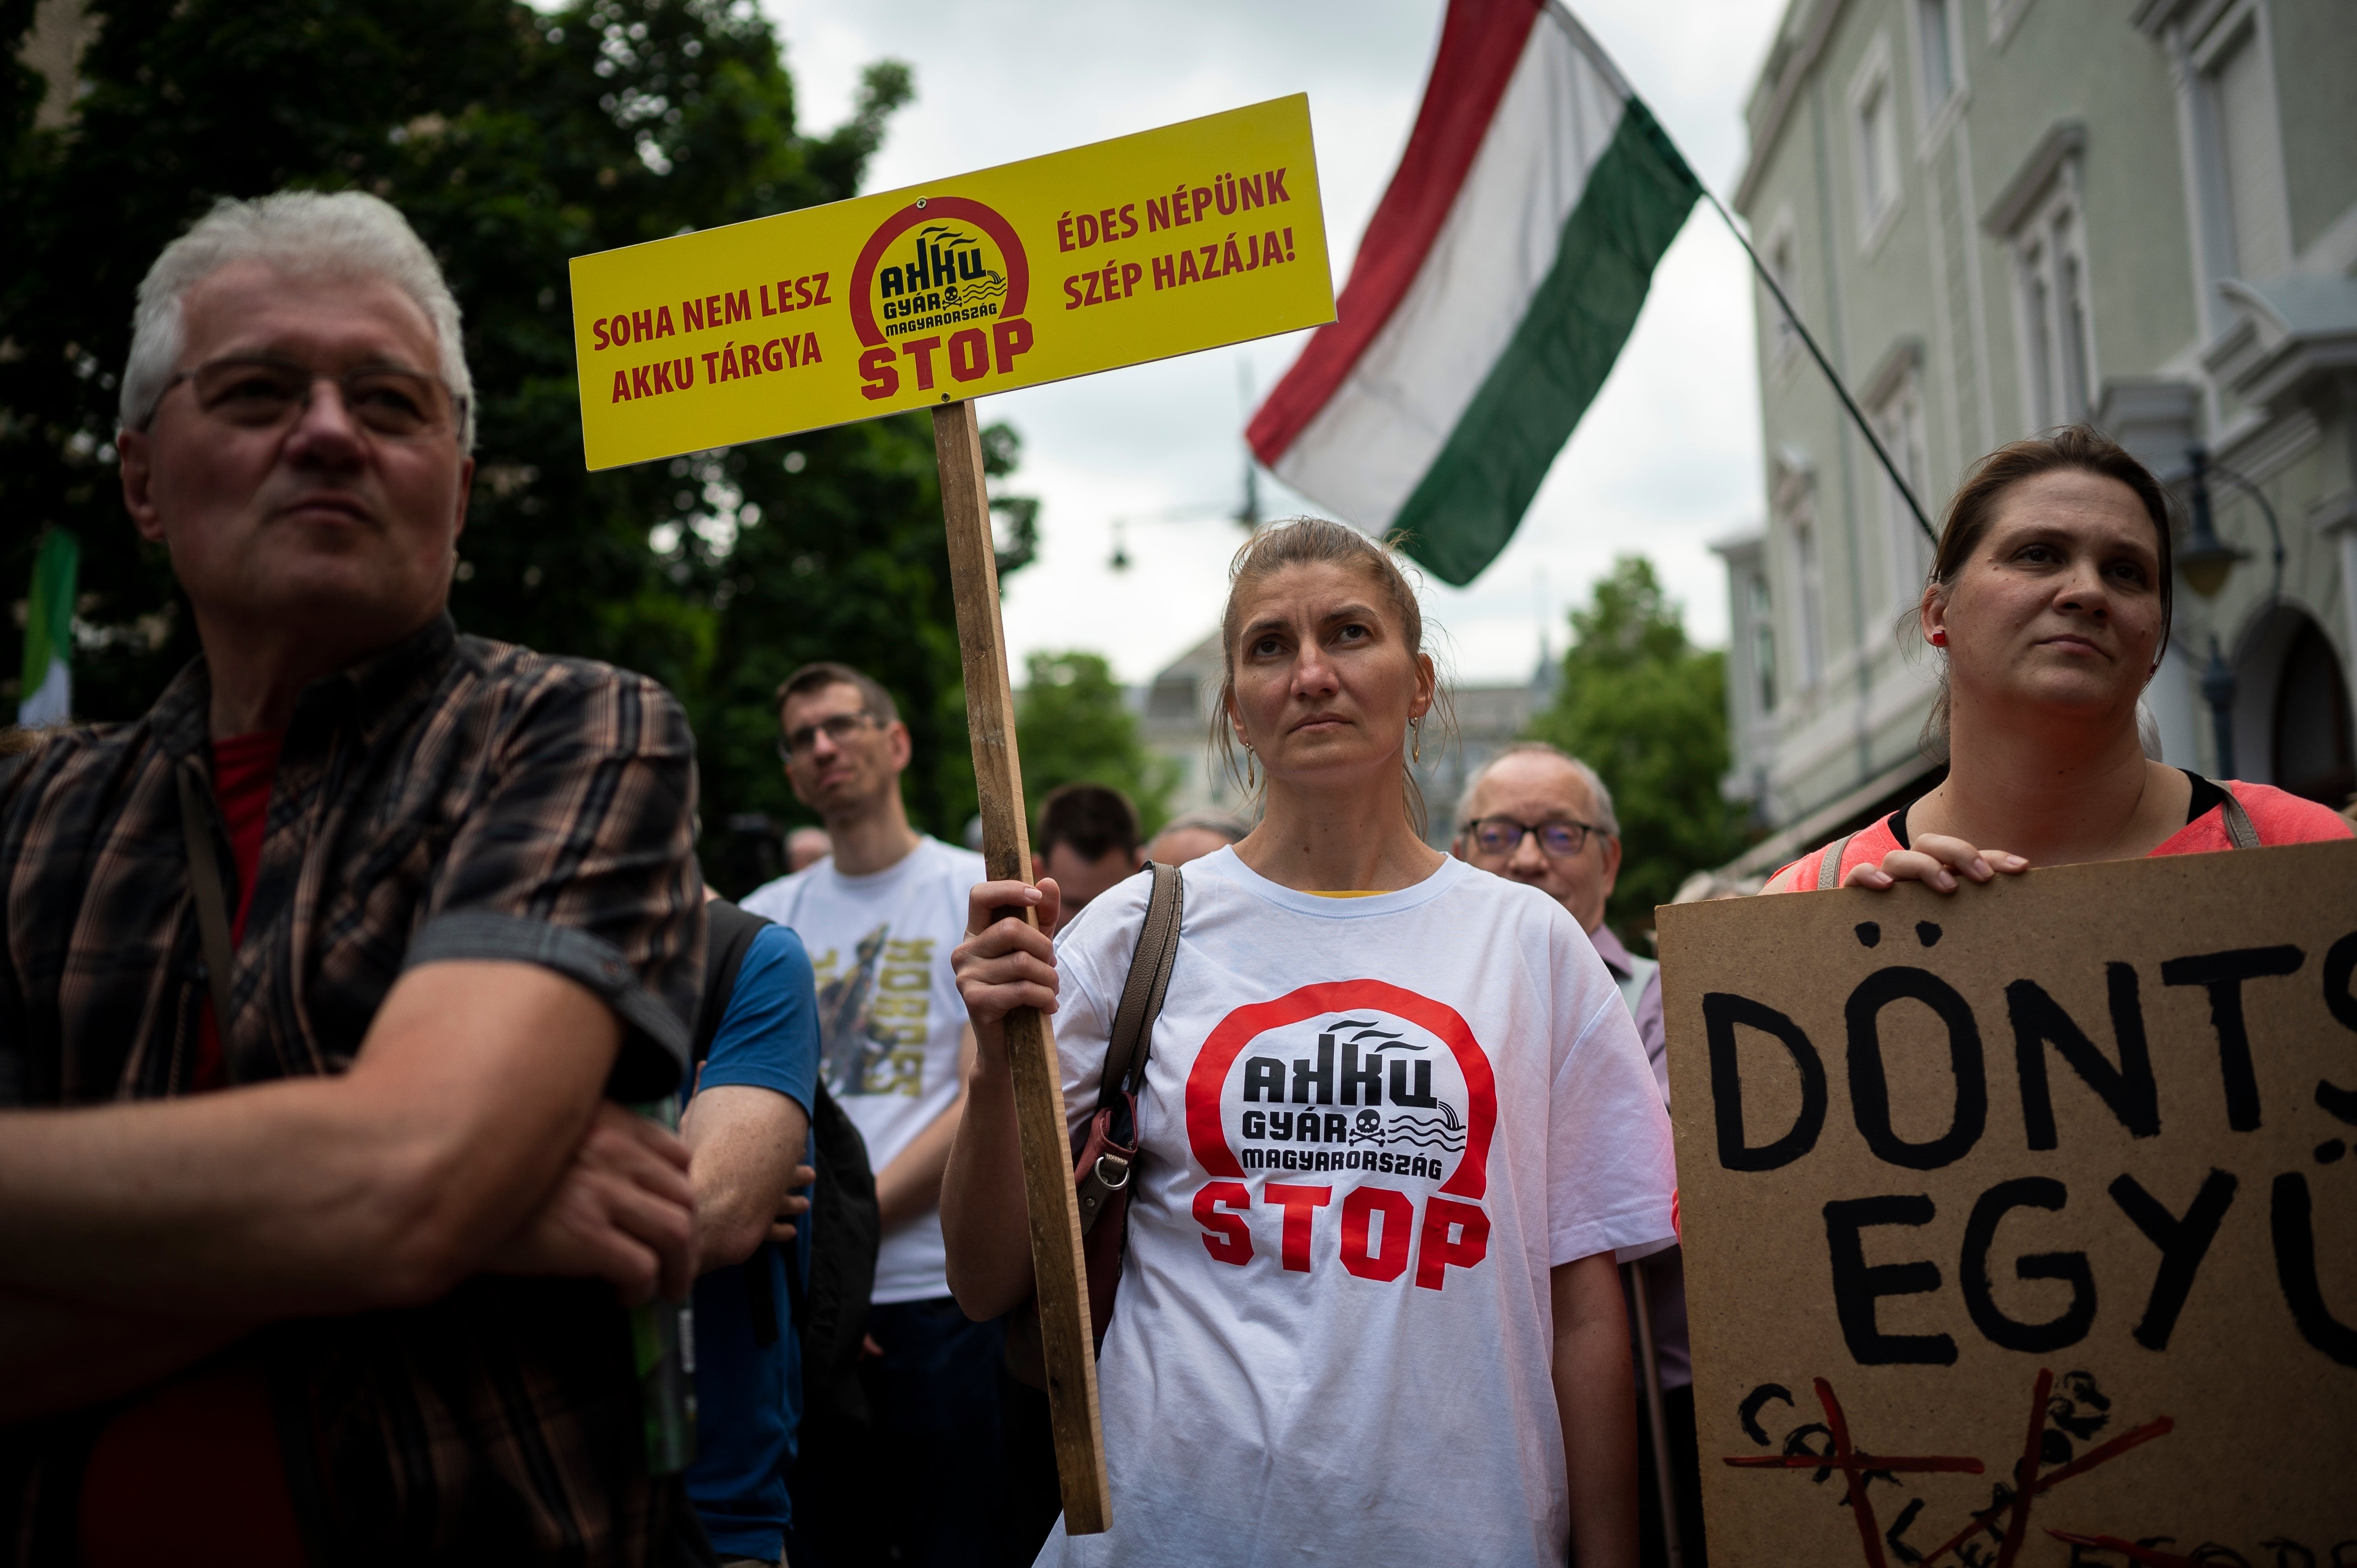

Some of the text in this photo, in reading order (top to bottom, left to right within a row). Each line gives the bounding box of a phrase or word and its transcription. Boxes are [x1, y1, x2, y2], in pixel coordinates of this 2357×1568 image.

[1056, 167, 1291, 253] ÉDES NÉPÜNK
[879, 237, 987, 299] AKKU
[1063, 226, 1296, 310] SZÉP HAZÁJA!
[592, 271, 832, 351] SOHA NEM LESZ
[883, 292, 941, 320] GYÁR
[885, 302, 998, 337] MAGYARORSZÁG
[612, 331, 823, 404] AKKU TÁRGYA
[858, 317, 1034, 401] STOP
[1243, 1033, 1438, 1109] AKKU
[1242, 1106, 1347, 1143] GYÁR
[1241, 1148, 1443, 1181] MAGYARORSZÁG
[1192, 1181, 1492, 1291] STOP
